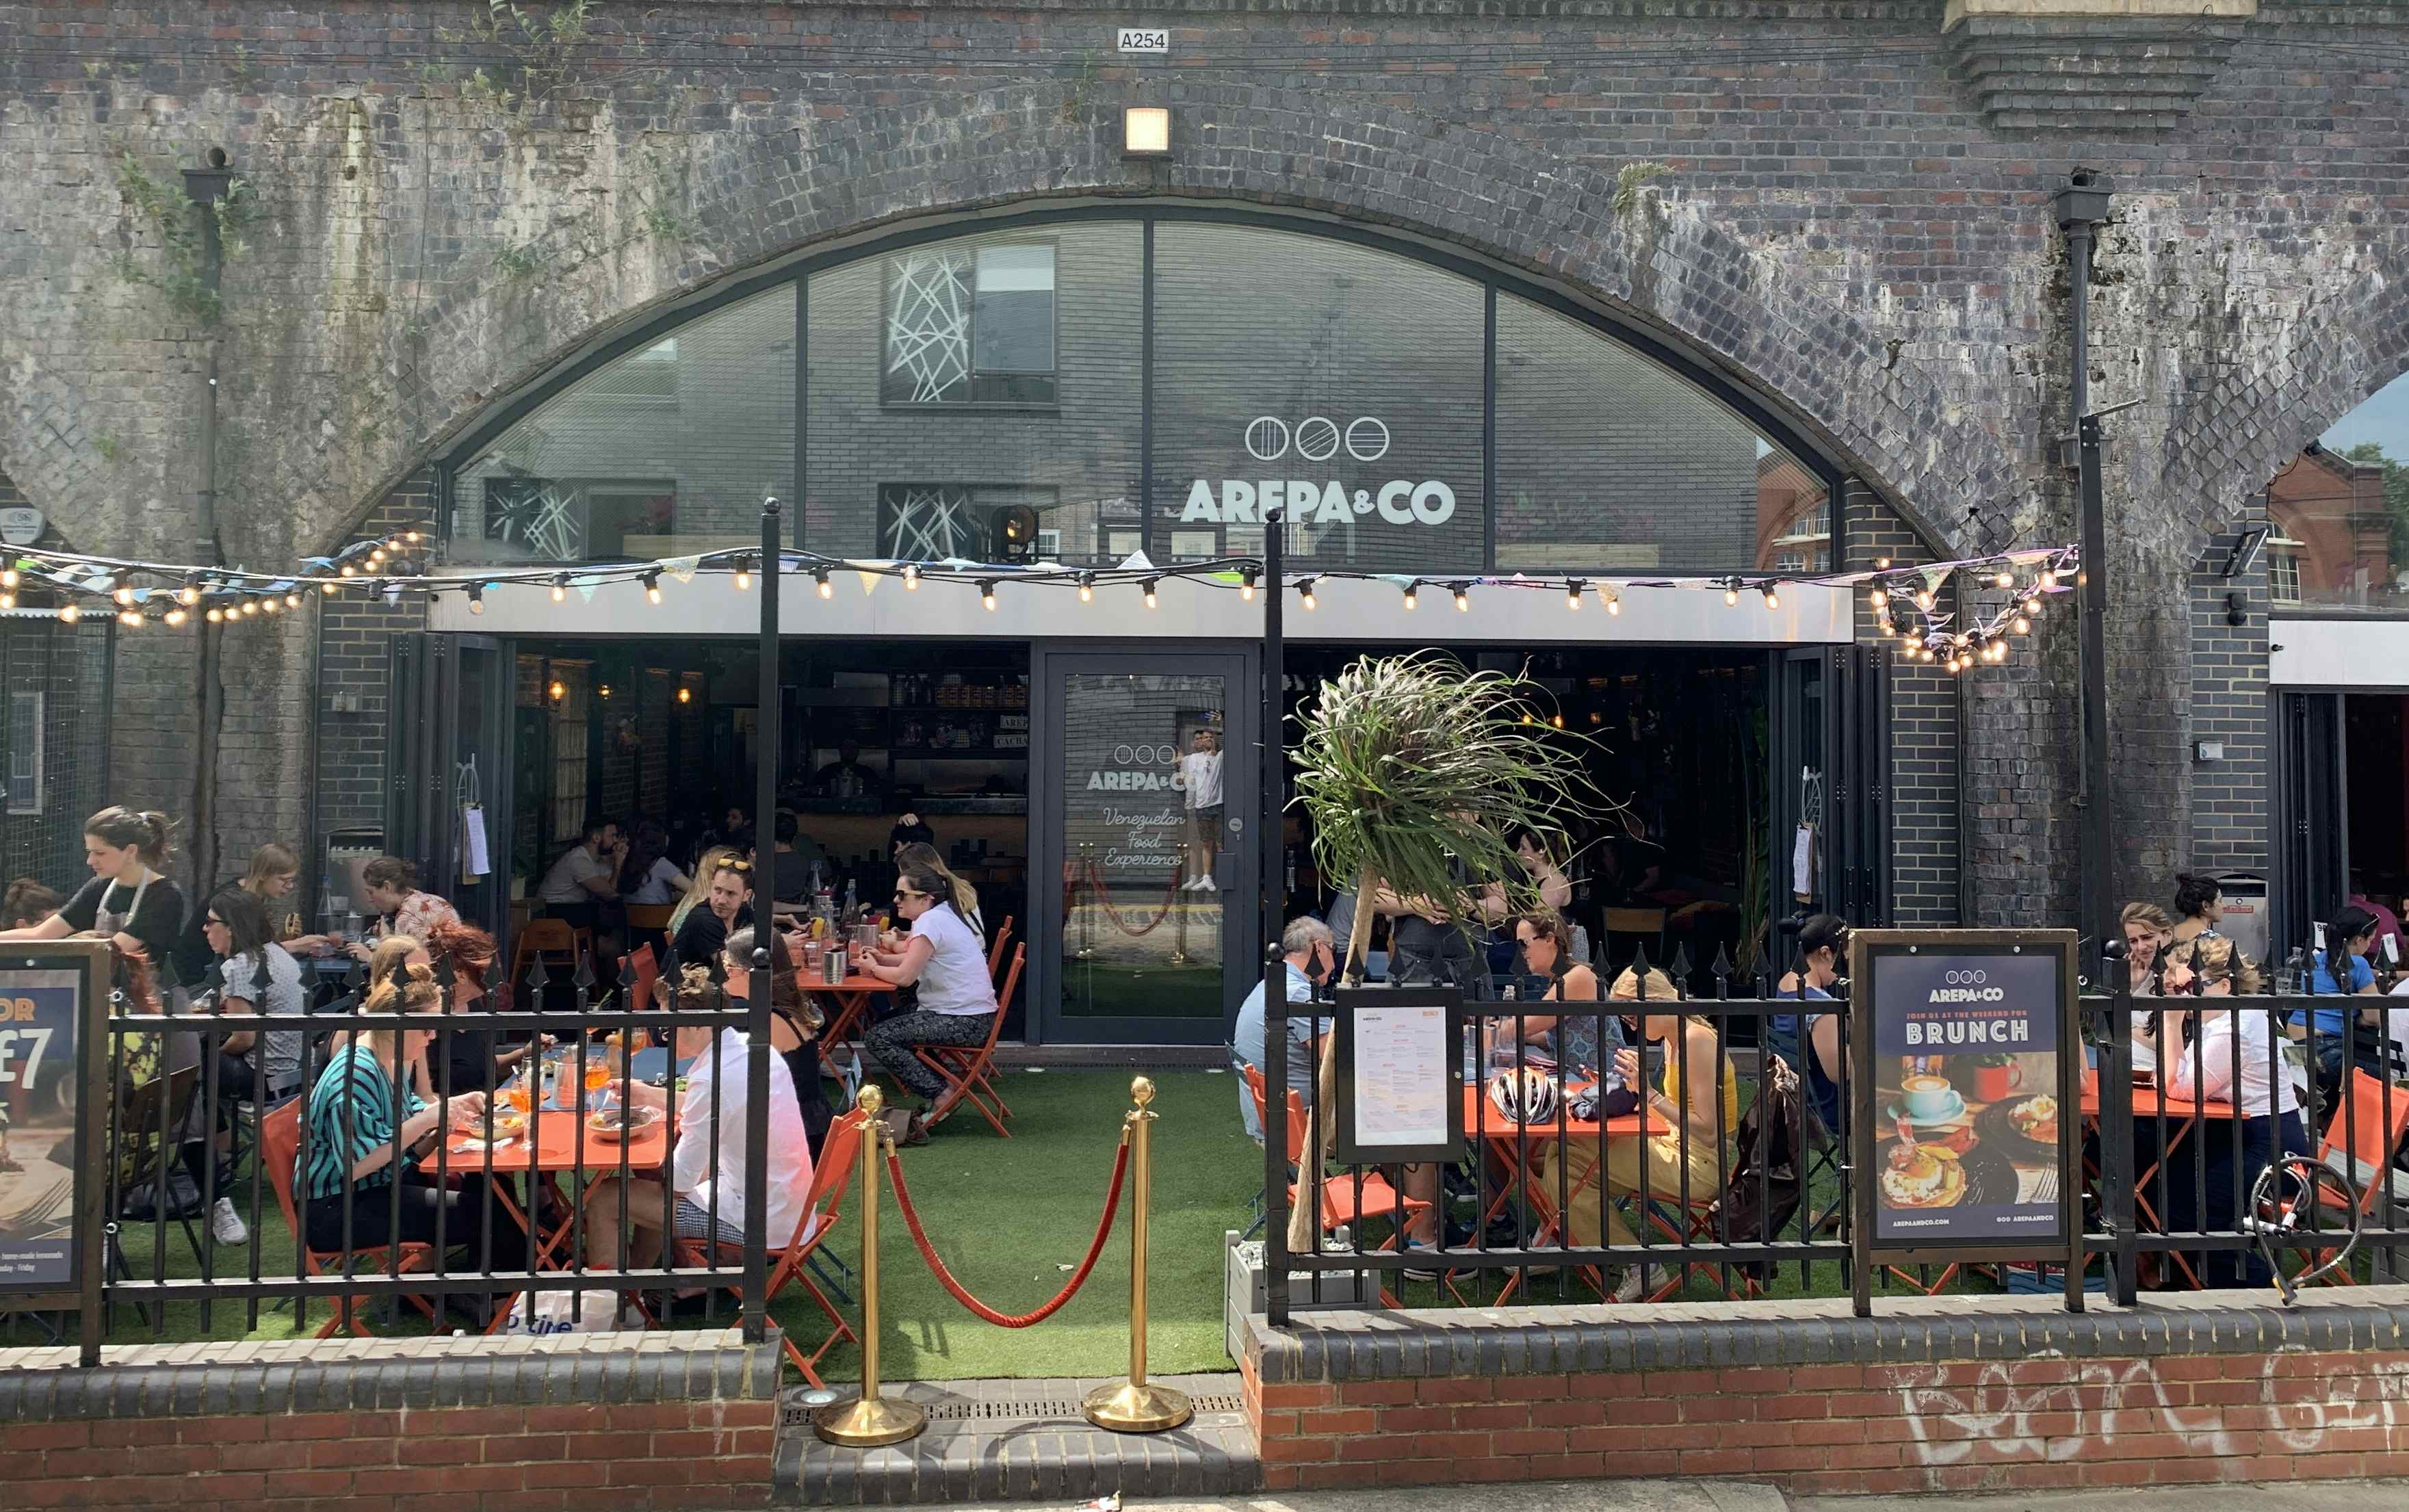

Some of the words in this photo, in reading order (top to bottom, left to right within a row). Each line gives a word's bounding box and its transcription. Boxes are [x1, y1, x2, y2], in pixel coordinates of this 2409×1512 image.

[1121, 31, 1166, 49] A254
[1180, 478, 1455, 525] AREPA&CO
[1103, 807, 1186, 829] Venezuelan
[1128, 831, 1162, 849] Food
[1104, 848, 1183, 869] Experience
[1929, 987, 2004, 1002] AREPA&CO
[1906, 1019, 2029, 1045] BRUNCH
[0, 1028, 53, 1090] £7
[1892, 1218, 1949, 1227] AREPAANDCO.COM
